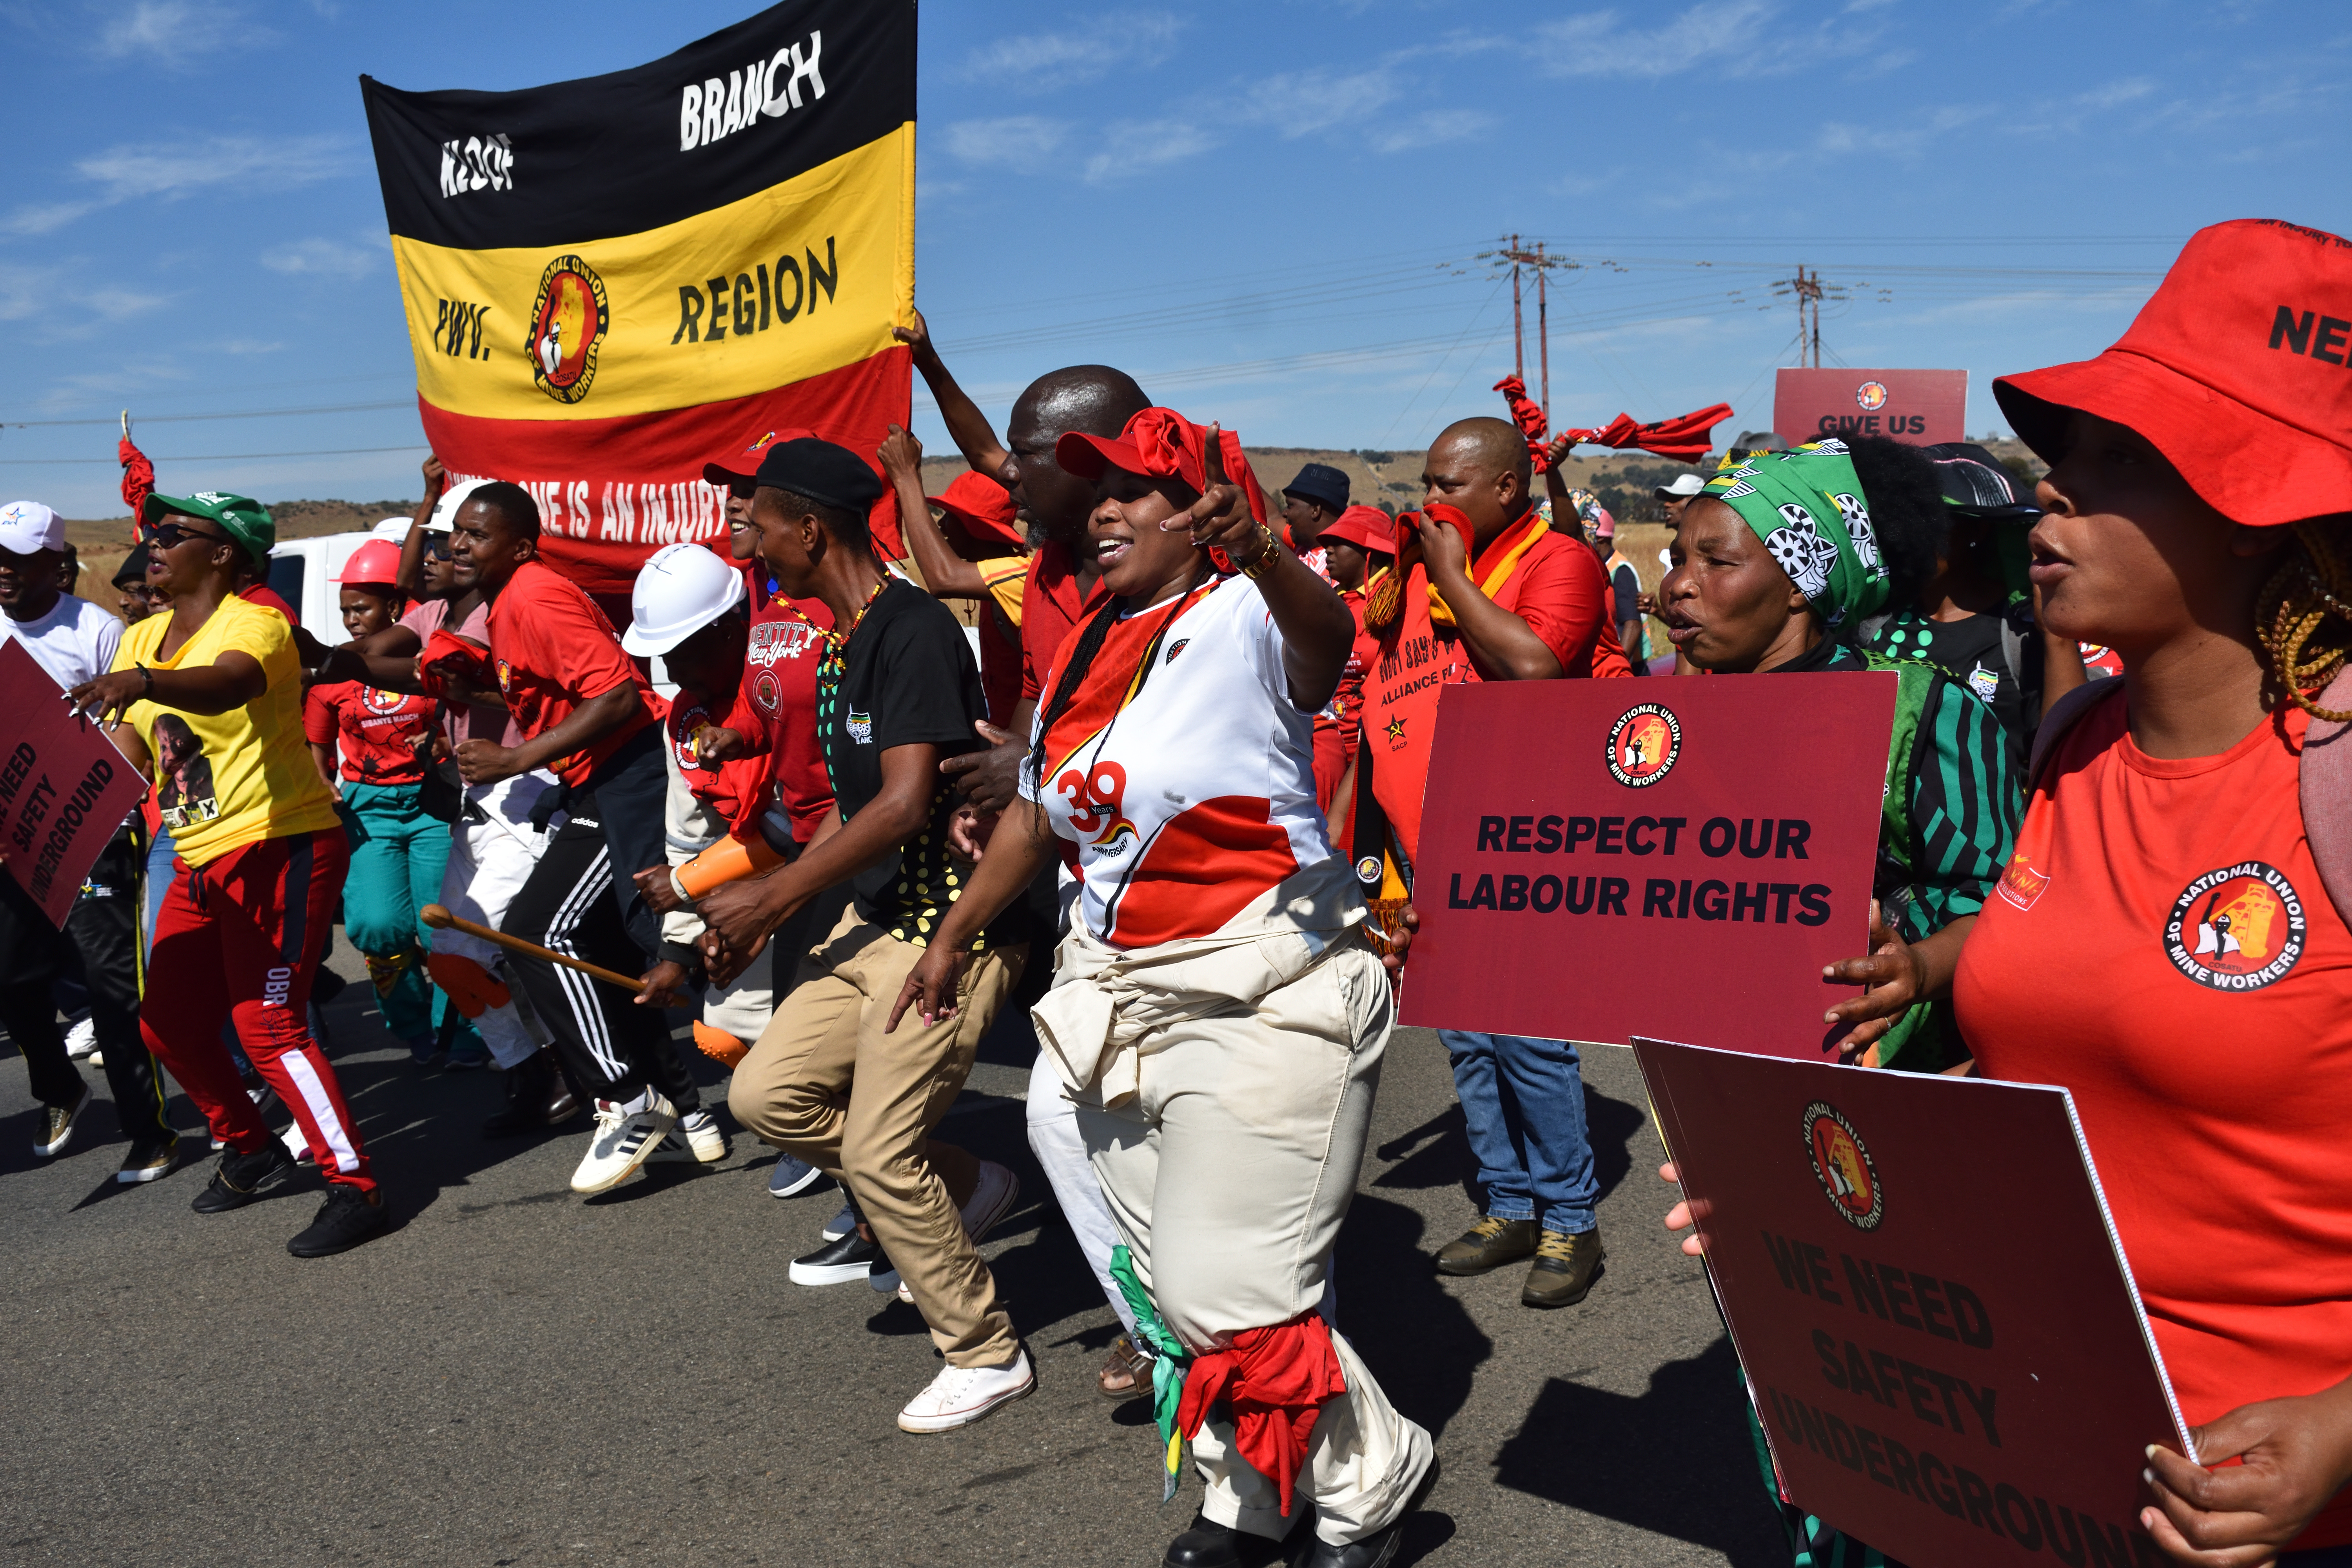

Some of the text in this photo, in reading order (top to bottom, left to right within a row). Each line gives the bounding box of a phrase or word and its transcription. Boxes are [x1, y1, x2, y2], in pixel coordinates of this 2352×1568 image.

[681, 30, 826, 151] BRANCH
[533, 257, 606, 324] NATIONAL UNION
[671, 236, 837, 345] REGION
[2268, 305, 2352, 370] NE
[527, 333, 604, 402] OF MINE WORKERS
[555, 372, 577, 384] COSATU
[1818, 415, 1925, 435] GIVE US
[518, 479, 728, 545] NE IS AN INJURY
[748, 640, 802, 668] New York
[749, 622, 823, 649] DENTITY
[1169, 640, 1187, 658] NATION
[1381, 671, 1439, 708] ALLIANCE
[1981, 694, 1995, 703] ANC
[361, 713, 419, 728] SIBANYE MARCH
[1611, 704, 1681, 742] NATIONAL UNION
[1392, 741, 1408, 752] SACP
[1608, 746, 1677, 786] OF MINE WORKERS
[0, 742, 36, 804] NEED
[12, 773, 57, 853] SAFETY
[29, 759, 114, 903] UNDERGROUND
[571, 817, 599, 828] adidas
[1091, 806, 1114, 814] Years
[1092, 837, 1128, 858] ANNIVERSARY
[1477, 815, 1811, 860] RESPECT OUR
[1448, 873, 1833, 926] LABOUR RIGHTS
[2002, 884, 2027, 905] SOLUTIONS
[2178, 863, 2304, 929] NATIONAL UNION
[2167, 922, 2299, 989] OF MINE WORKERS
[2208, 962, 2243, 973] COSATU
[263, 967, 291, 1006] OBR
[1803, 1103, 1873, 1166] NATIONAL UNION
[1813, 1161, 1882, 1229] OF MINE WORKERS
[1760, 1229, 1994, 1350] WE NEED
[1811, 1328, 2002, 1449] SAFETY
